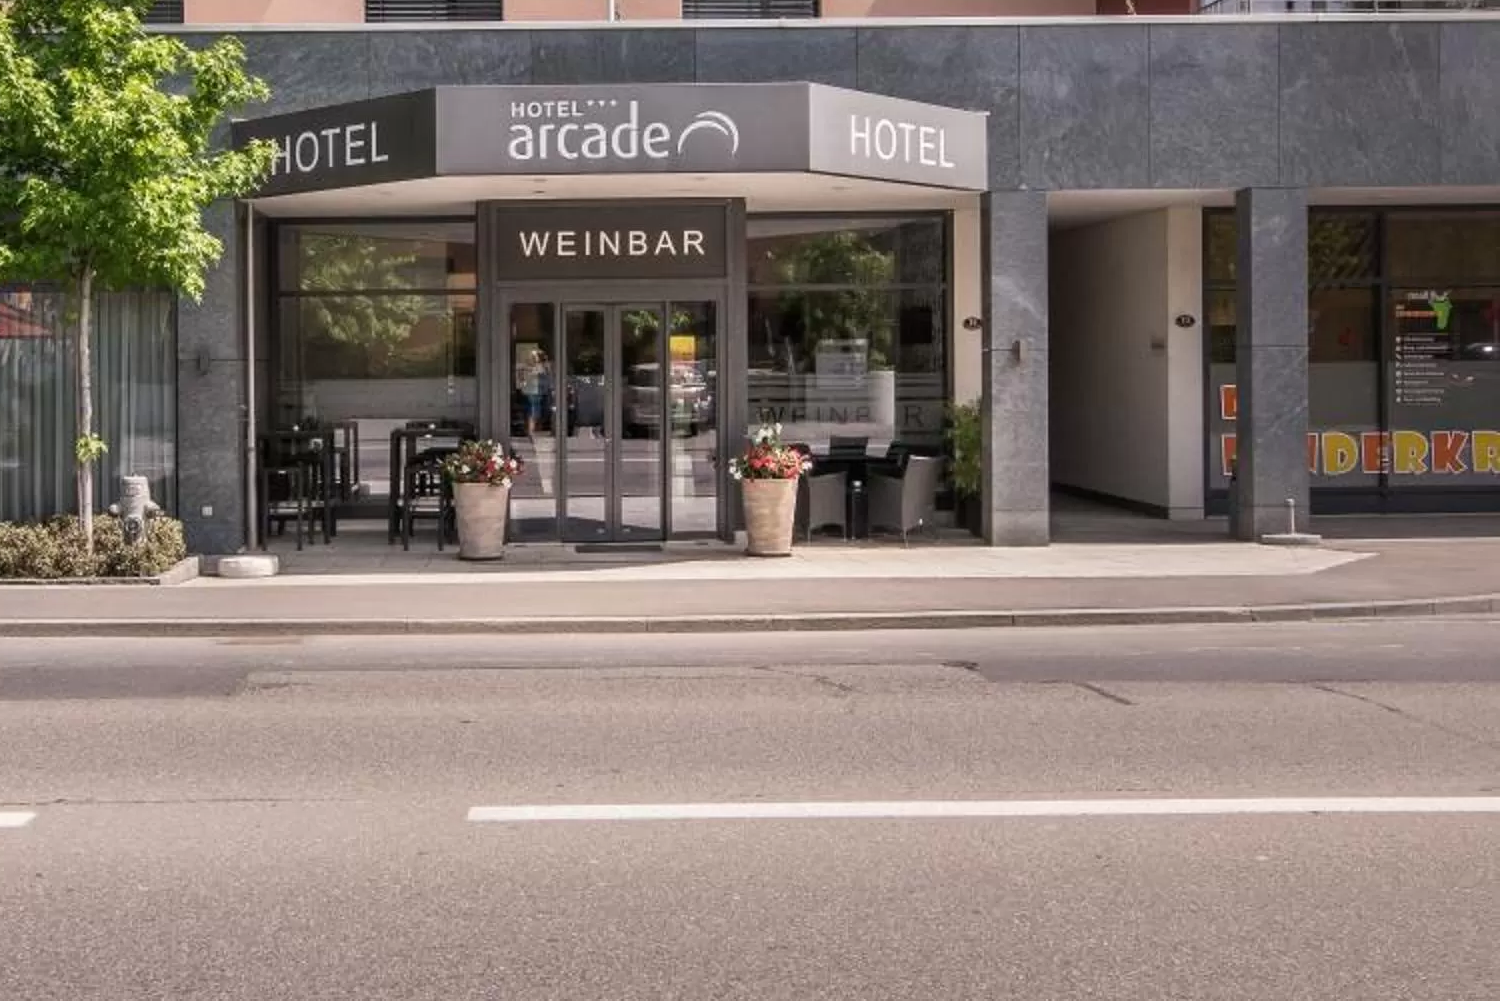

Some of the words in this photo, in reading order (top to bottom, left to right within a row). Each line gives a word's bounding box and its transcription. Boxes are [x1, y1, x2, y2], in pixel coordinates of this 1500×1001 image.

[508, 100, 671, 159] arcade
[511, 101, 584, 118] HOTEL
[271, 121, 389, 175] HOTEL
[851, 114, 956, 168] HOTEL
[519, 230, 705, 257] WEINBAR
